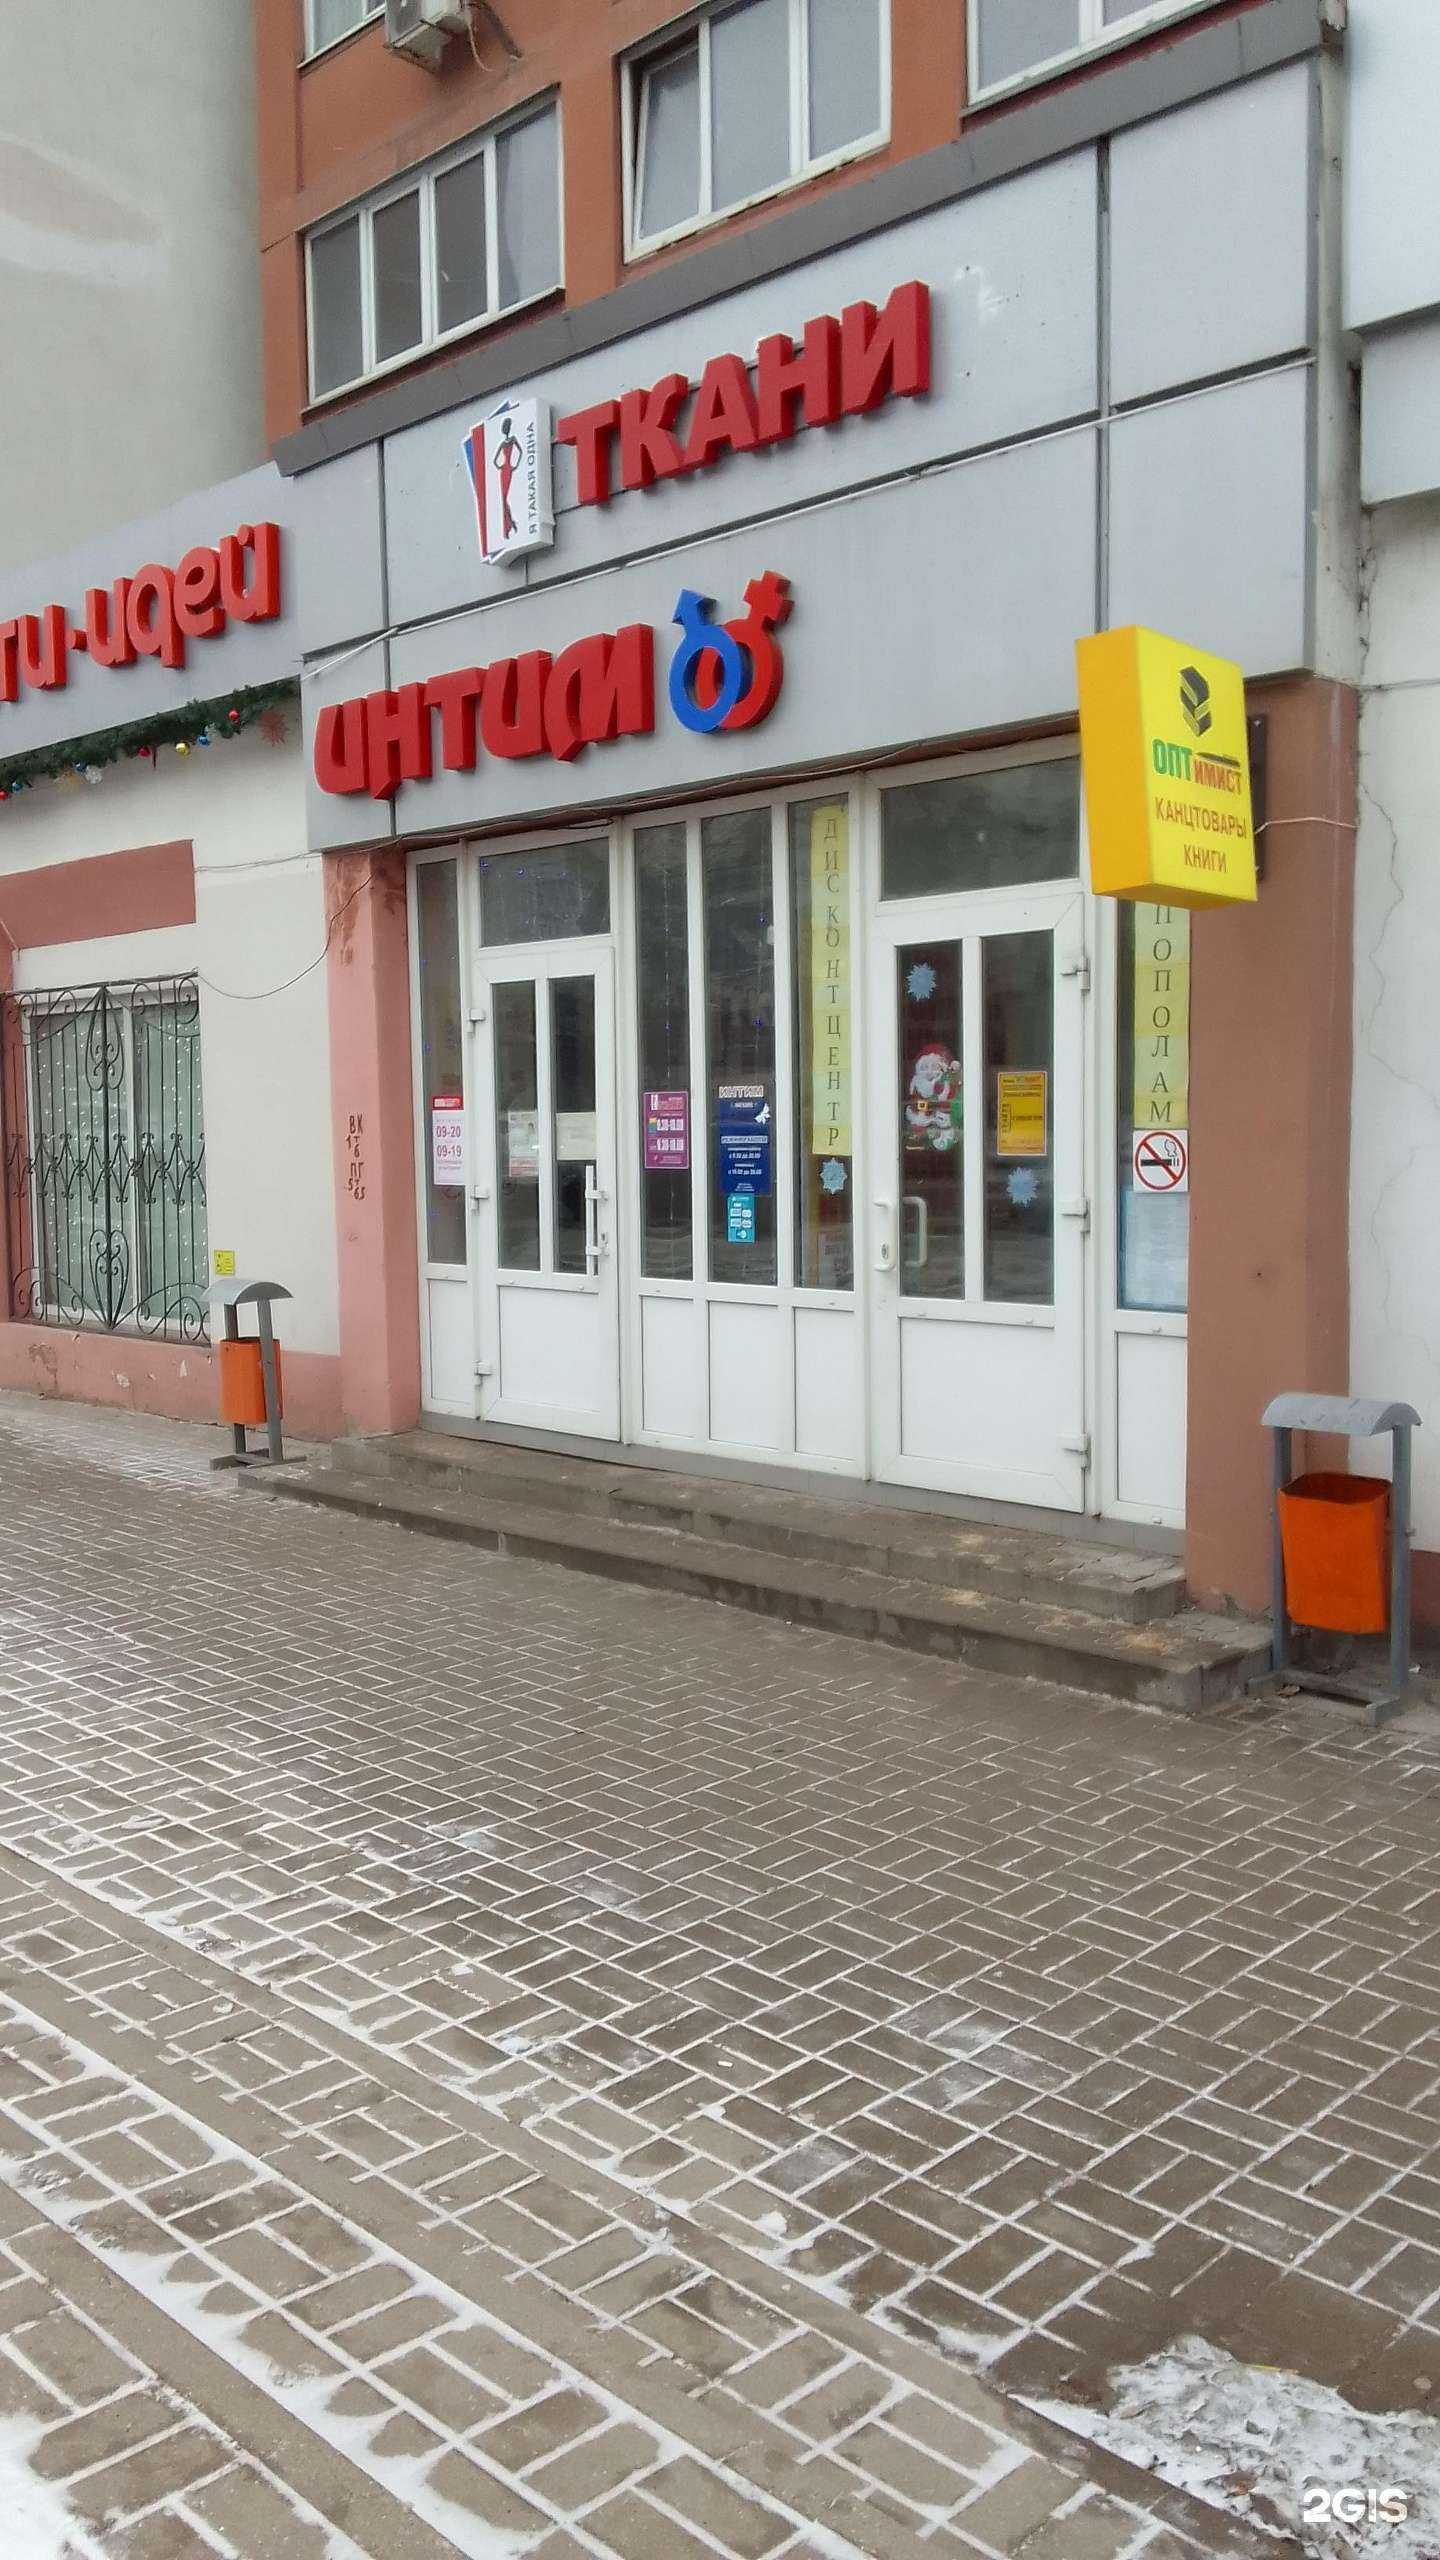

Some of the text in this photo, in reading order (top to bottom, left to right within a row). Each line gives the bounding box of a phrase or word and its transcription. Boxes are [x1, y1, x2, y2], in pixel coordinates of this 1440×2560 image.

[557, 280, 930, 505] ТКАНИ
[526, 421, 537, 535] Я ТАКАЯ ОДНА
[1154, 797, 1248, 839] КАНЦТОВАРЫ
[1183, 844, 1228, 873] КНИГИ
[436, 1125, 461, 1138] 09-20
[436, 1144, 462, 1157] 09-19
